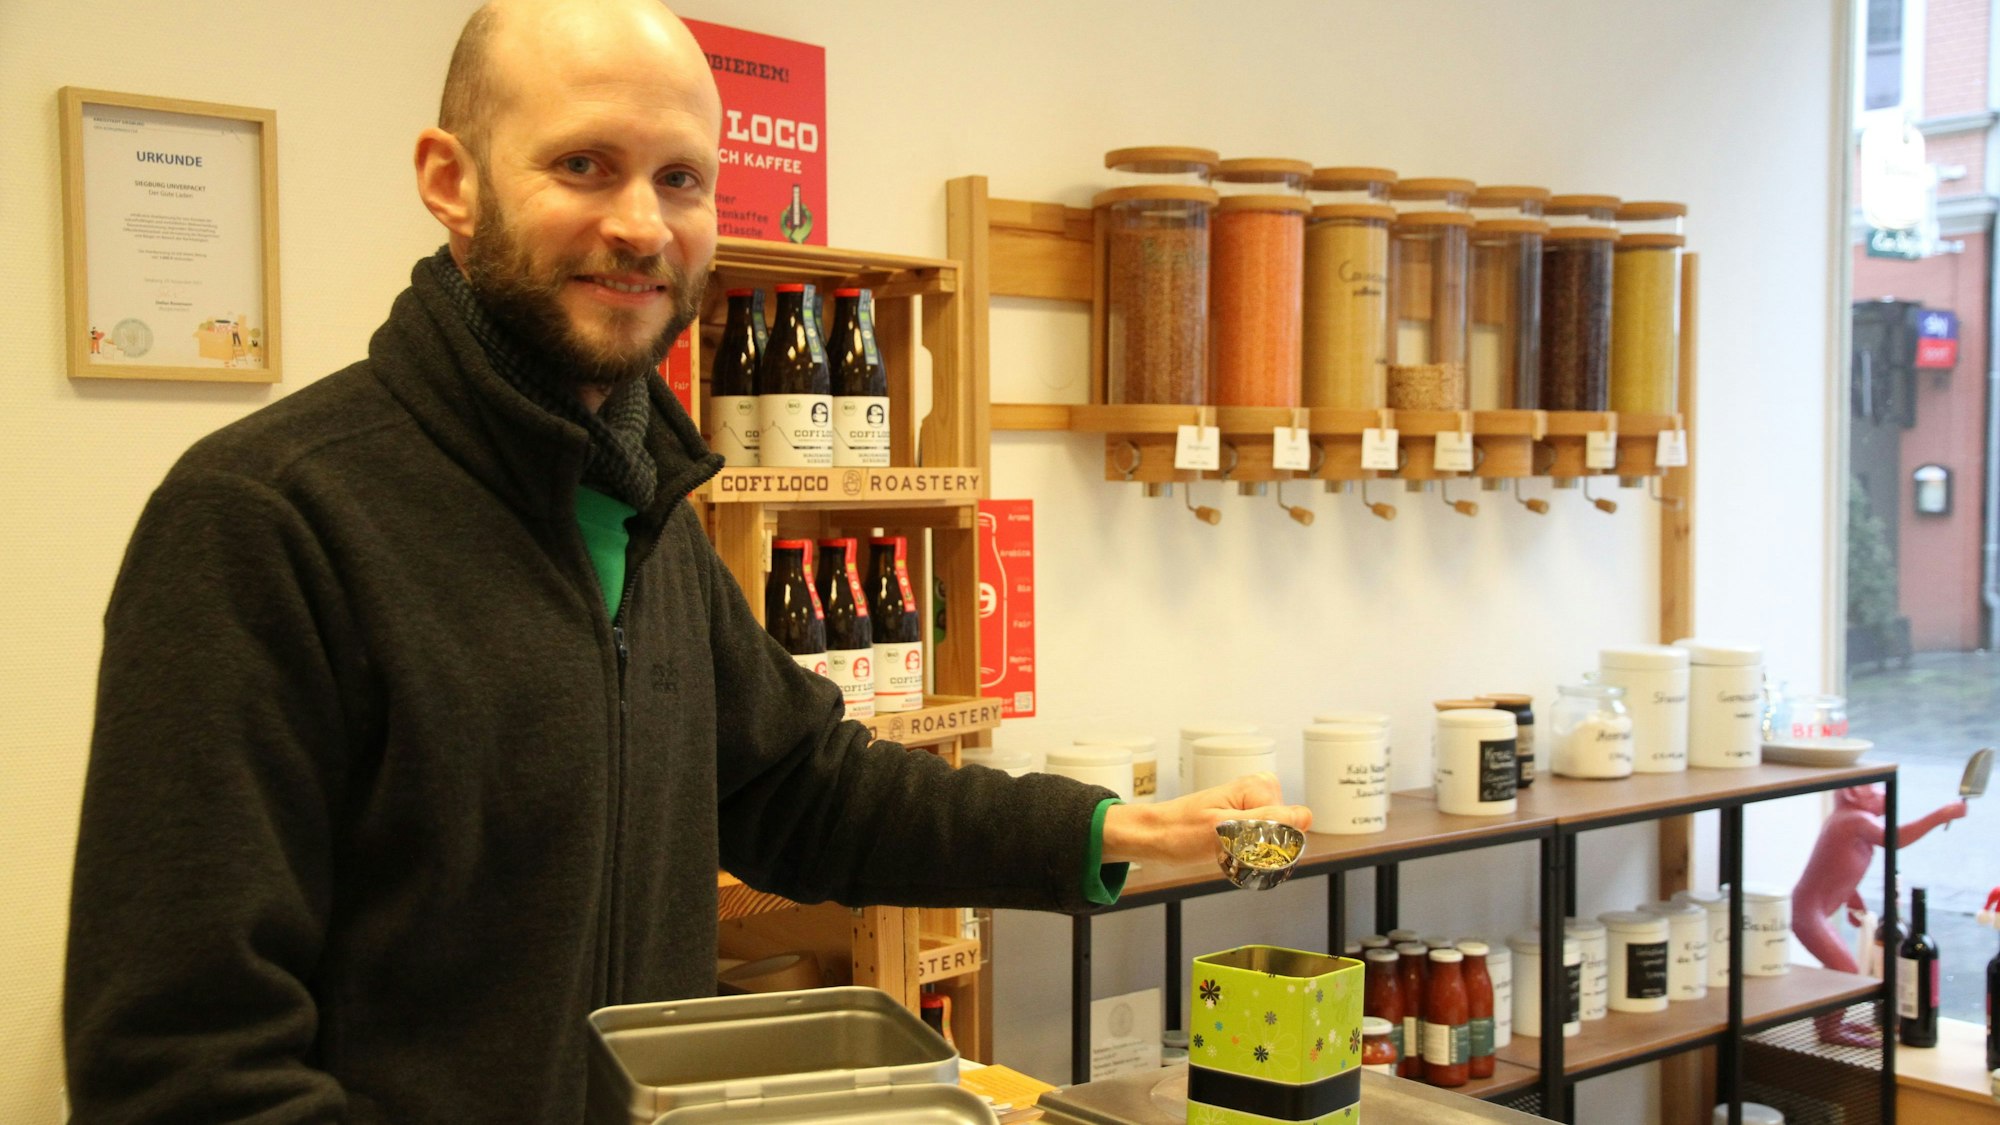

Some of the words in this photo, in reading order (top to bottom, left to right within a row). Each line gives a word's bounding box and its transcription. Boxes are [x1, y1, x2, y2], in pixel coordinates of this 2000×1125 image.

[726, 109, 819, 154] LOCO
[136, 150, 203, 167] URKUNDE
[743, 152, 802, 175] KAFFEE
[135, 180, 166, 189] SIEGBURG
[166, 183, 206, 192] UNVERPACKT
[674, 380, 689, 390] Fair
[794, 429, 820, 438] COFI
[849, 430, 875, 439] COFI
[720, 475, 772, 492] COFI
[776, 475, 829, 492] LOCO
[870, 474, 980, 491] ROASTERY
[1012, 619, 1032, 628] Fair
[911, 705, 999, 734] ROASTERY
[919, 948, 977, 977] STERY
